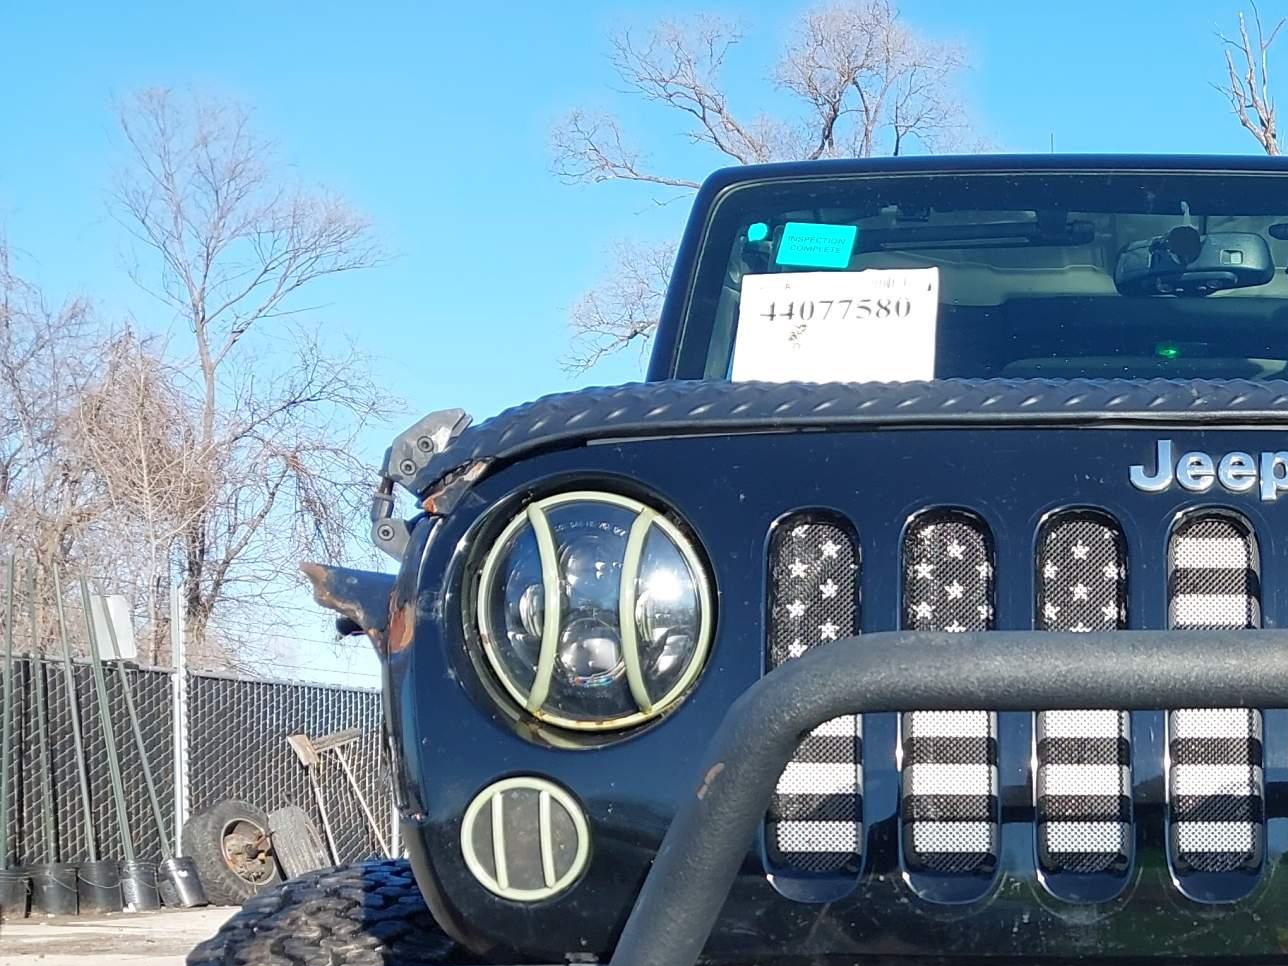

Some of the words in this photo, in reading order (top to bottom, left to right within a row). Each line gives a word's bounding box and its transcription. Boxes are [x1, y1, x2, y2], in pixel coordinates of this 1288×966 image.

[788, 235, 846, 245] INSPECTION
[790, 244, 841, 254] COMPLETE
[760, 298, 912, 321] 44077580
